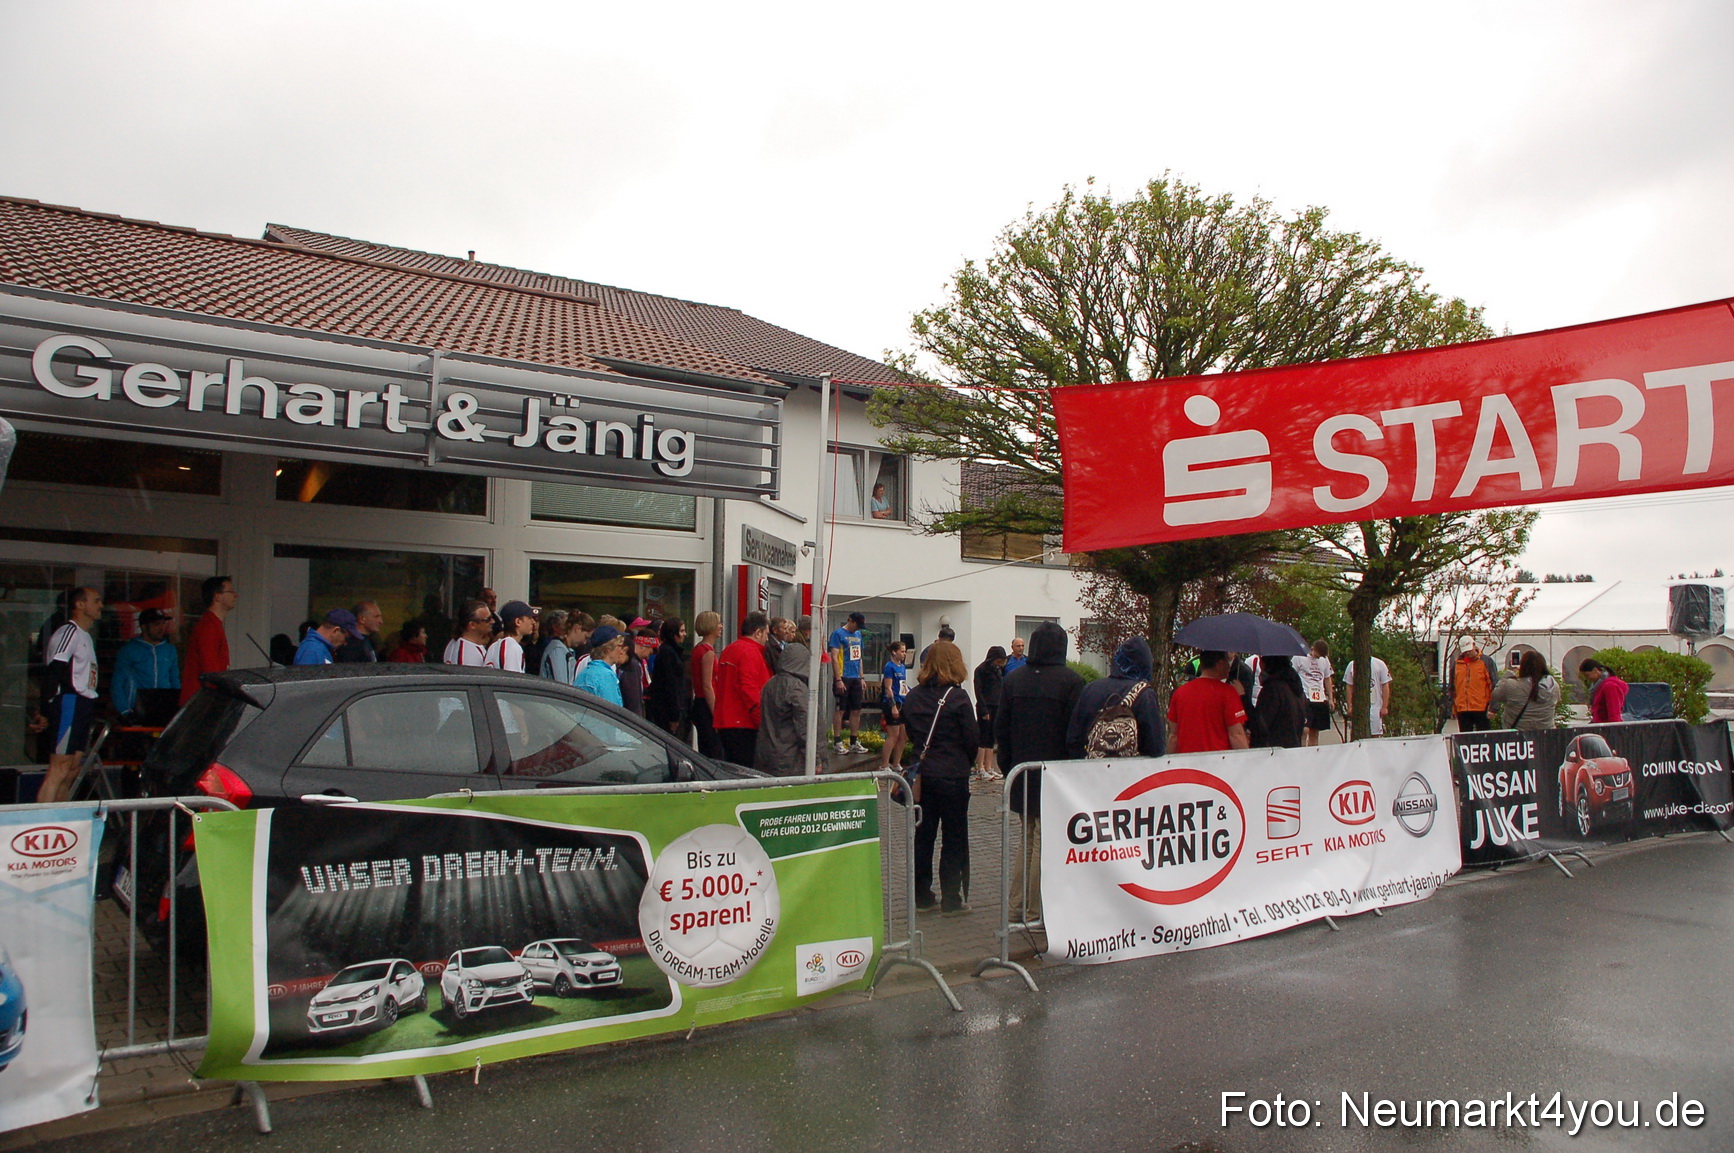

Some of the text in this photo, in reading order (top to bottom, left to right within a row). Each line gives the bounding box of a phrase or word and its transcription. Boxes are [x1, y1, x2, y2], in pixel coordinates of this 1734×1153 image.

[32, 333, 695, 477] Gerhart & Jänig
[1312, 361, 1734, 513] START
[1311, 691, 1320, 700] 43
[1460, 740, 1535, 764] DER NEUE
[1467, 769, 1537, 800] NISSAN
[1338, 790, 1375, 816] KIA
[1396, 797, 1433, 812] NISSAN
[759, 808, 866, 828] PROBE FAHREN UND REISE ZUR
[1066, 800, 1227, 845] GERHART &
[1470, 802, 1540, 850] JUKE
[24, 833, 67, 851] KIA
[760, 828, 779, 838] UEFA
[780, 826, 800, 836] EURO
[801, 824, 821, 834] 2012
[1065, 829, 1231, 870] Autohaus JÄNIG
[1255, 843, 1313, 864] SEAT
[1324, 836, 1346, 852] KIA
[7, 856, 77, 872] KIA MOTORS
[300, 847, 618, 894] UNSER DREAM-TEAM.
[687, 851, 736, 869] Bis zu
[659, 880, 674, 902] €
[670, 900, 752, 935] sparen!
[1065, 928, 1136, 959] Neumarkt
[1151, 913, 1231, 946] Sengenthal
[1238, 907, 1267, 928] Tel.
[1323, 887, 1351, 908] 80-0
[648, 917, 774, 980] Die DREAM-TEAM-Modelle
[841, 954, 861, 964] KIA
[424, 965, 442, 973] KIA
